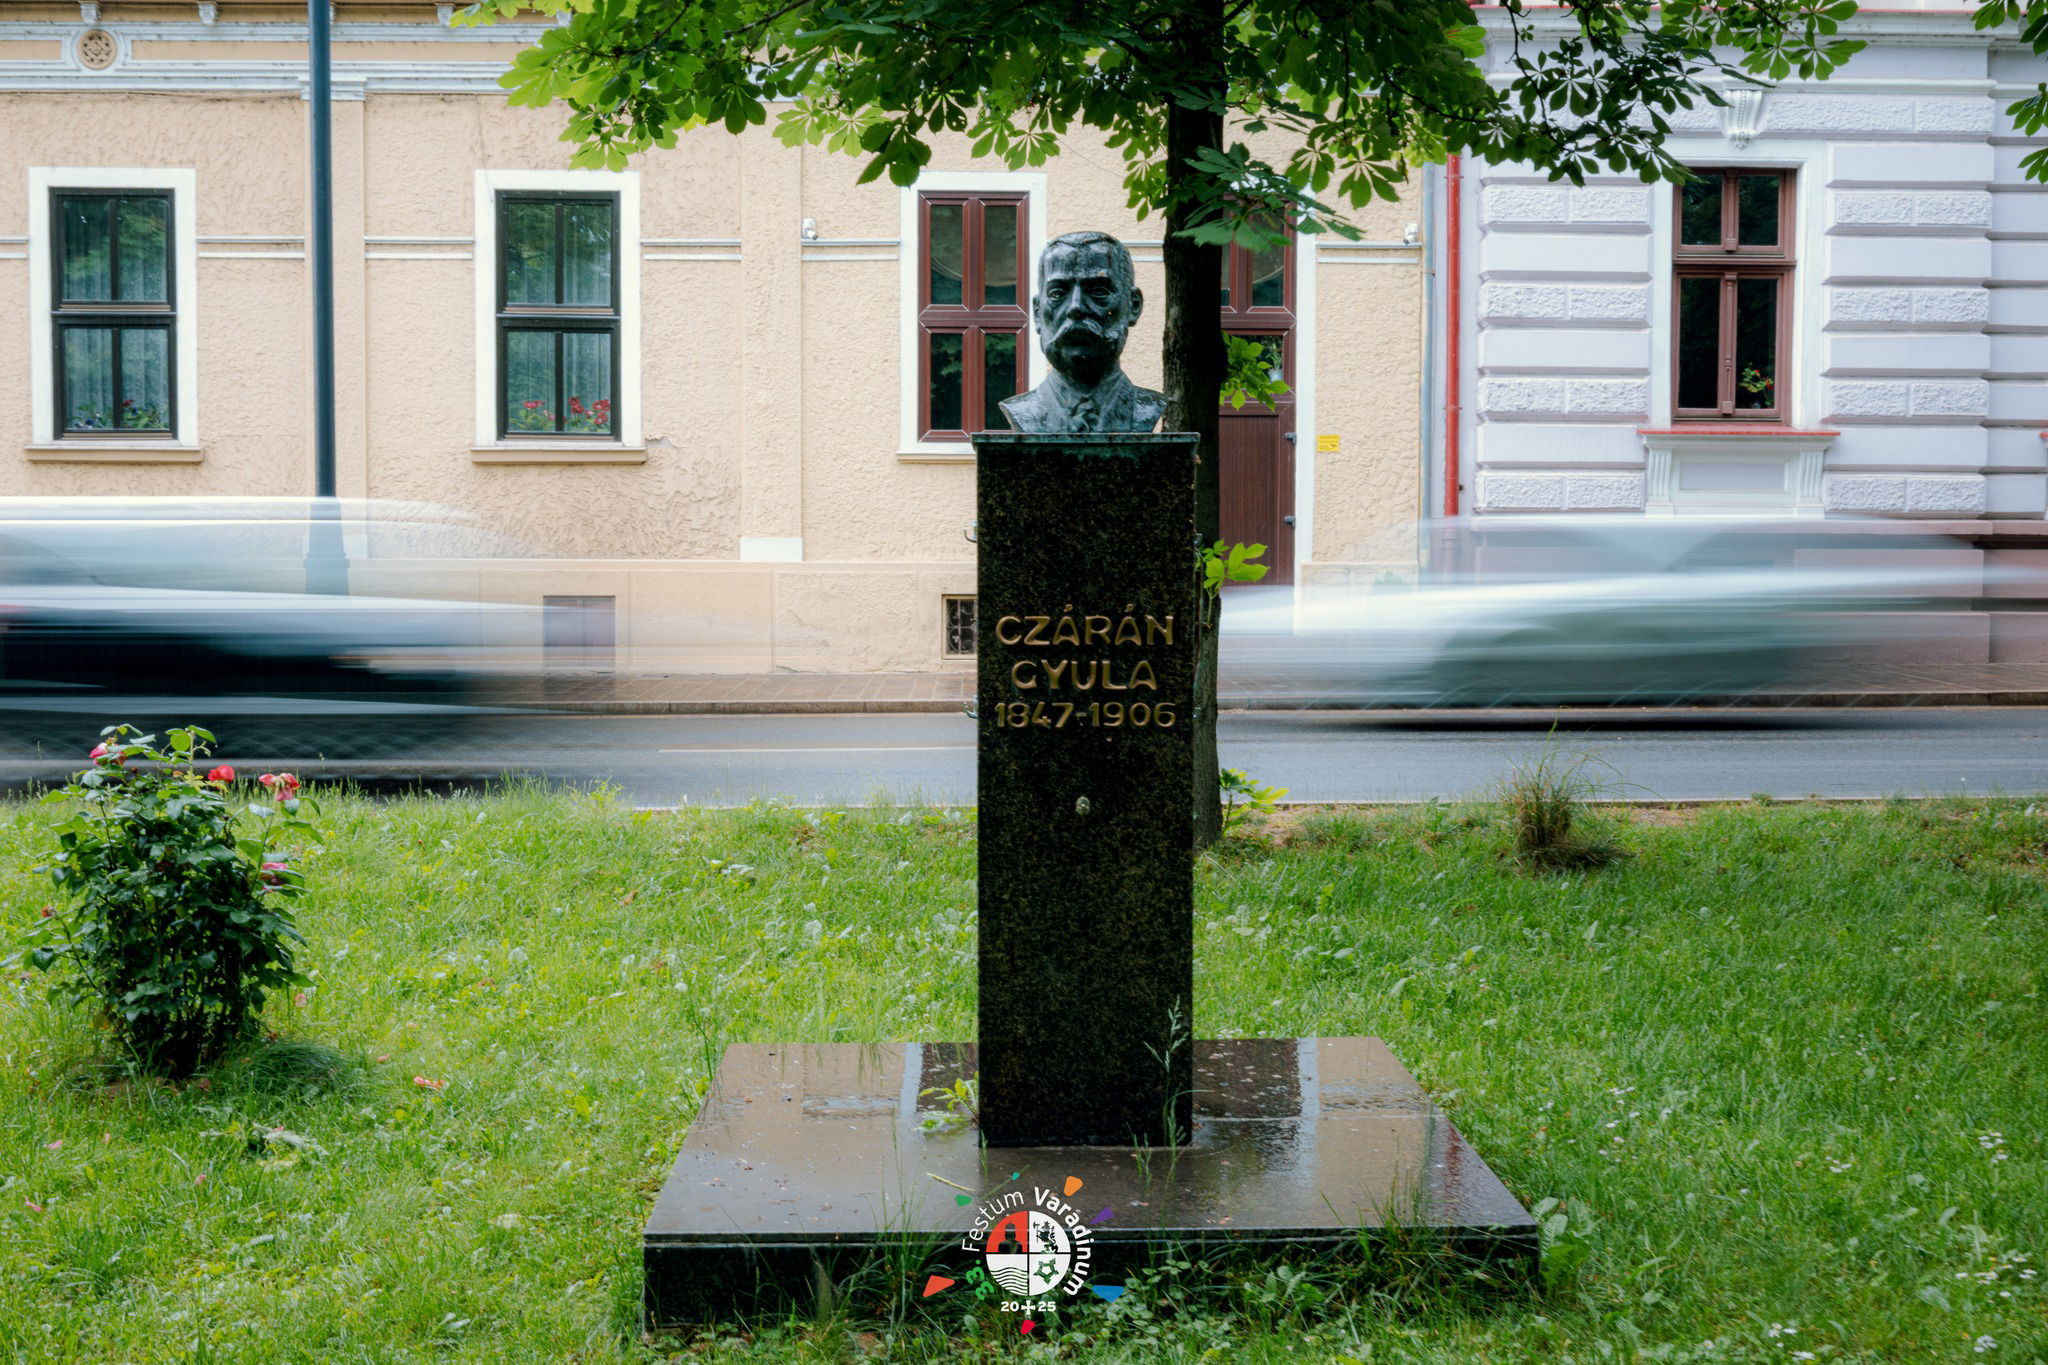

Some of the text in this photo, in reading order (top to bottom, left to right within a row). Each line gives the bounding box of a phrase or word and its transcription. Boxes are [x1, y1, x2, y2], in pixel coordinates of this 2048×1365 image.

[995, 603, 1174, 646] CZÁRÁN
[1011, 659, 1158, 690] GYULA
[994, 701, 1177, 728] 1847-1906
